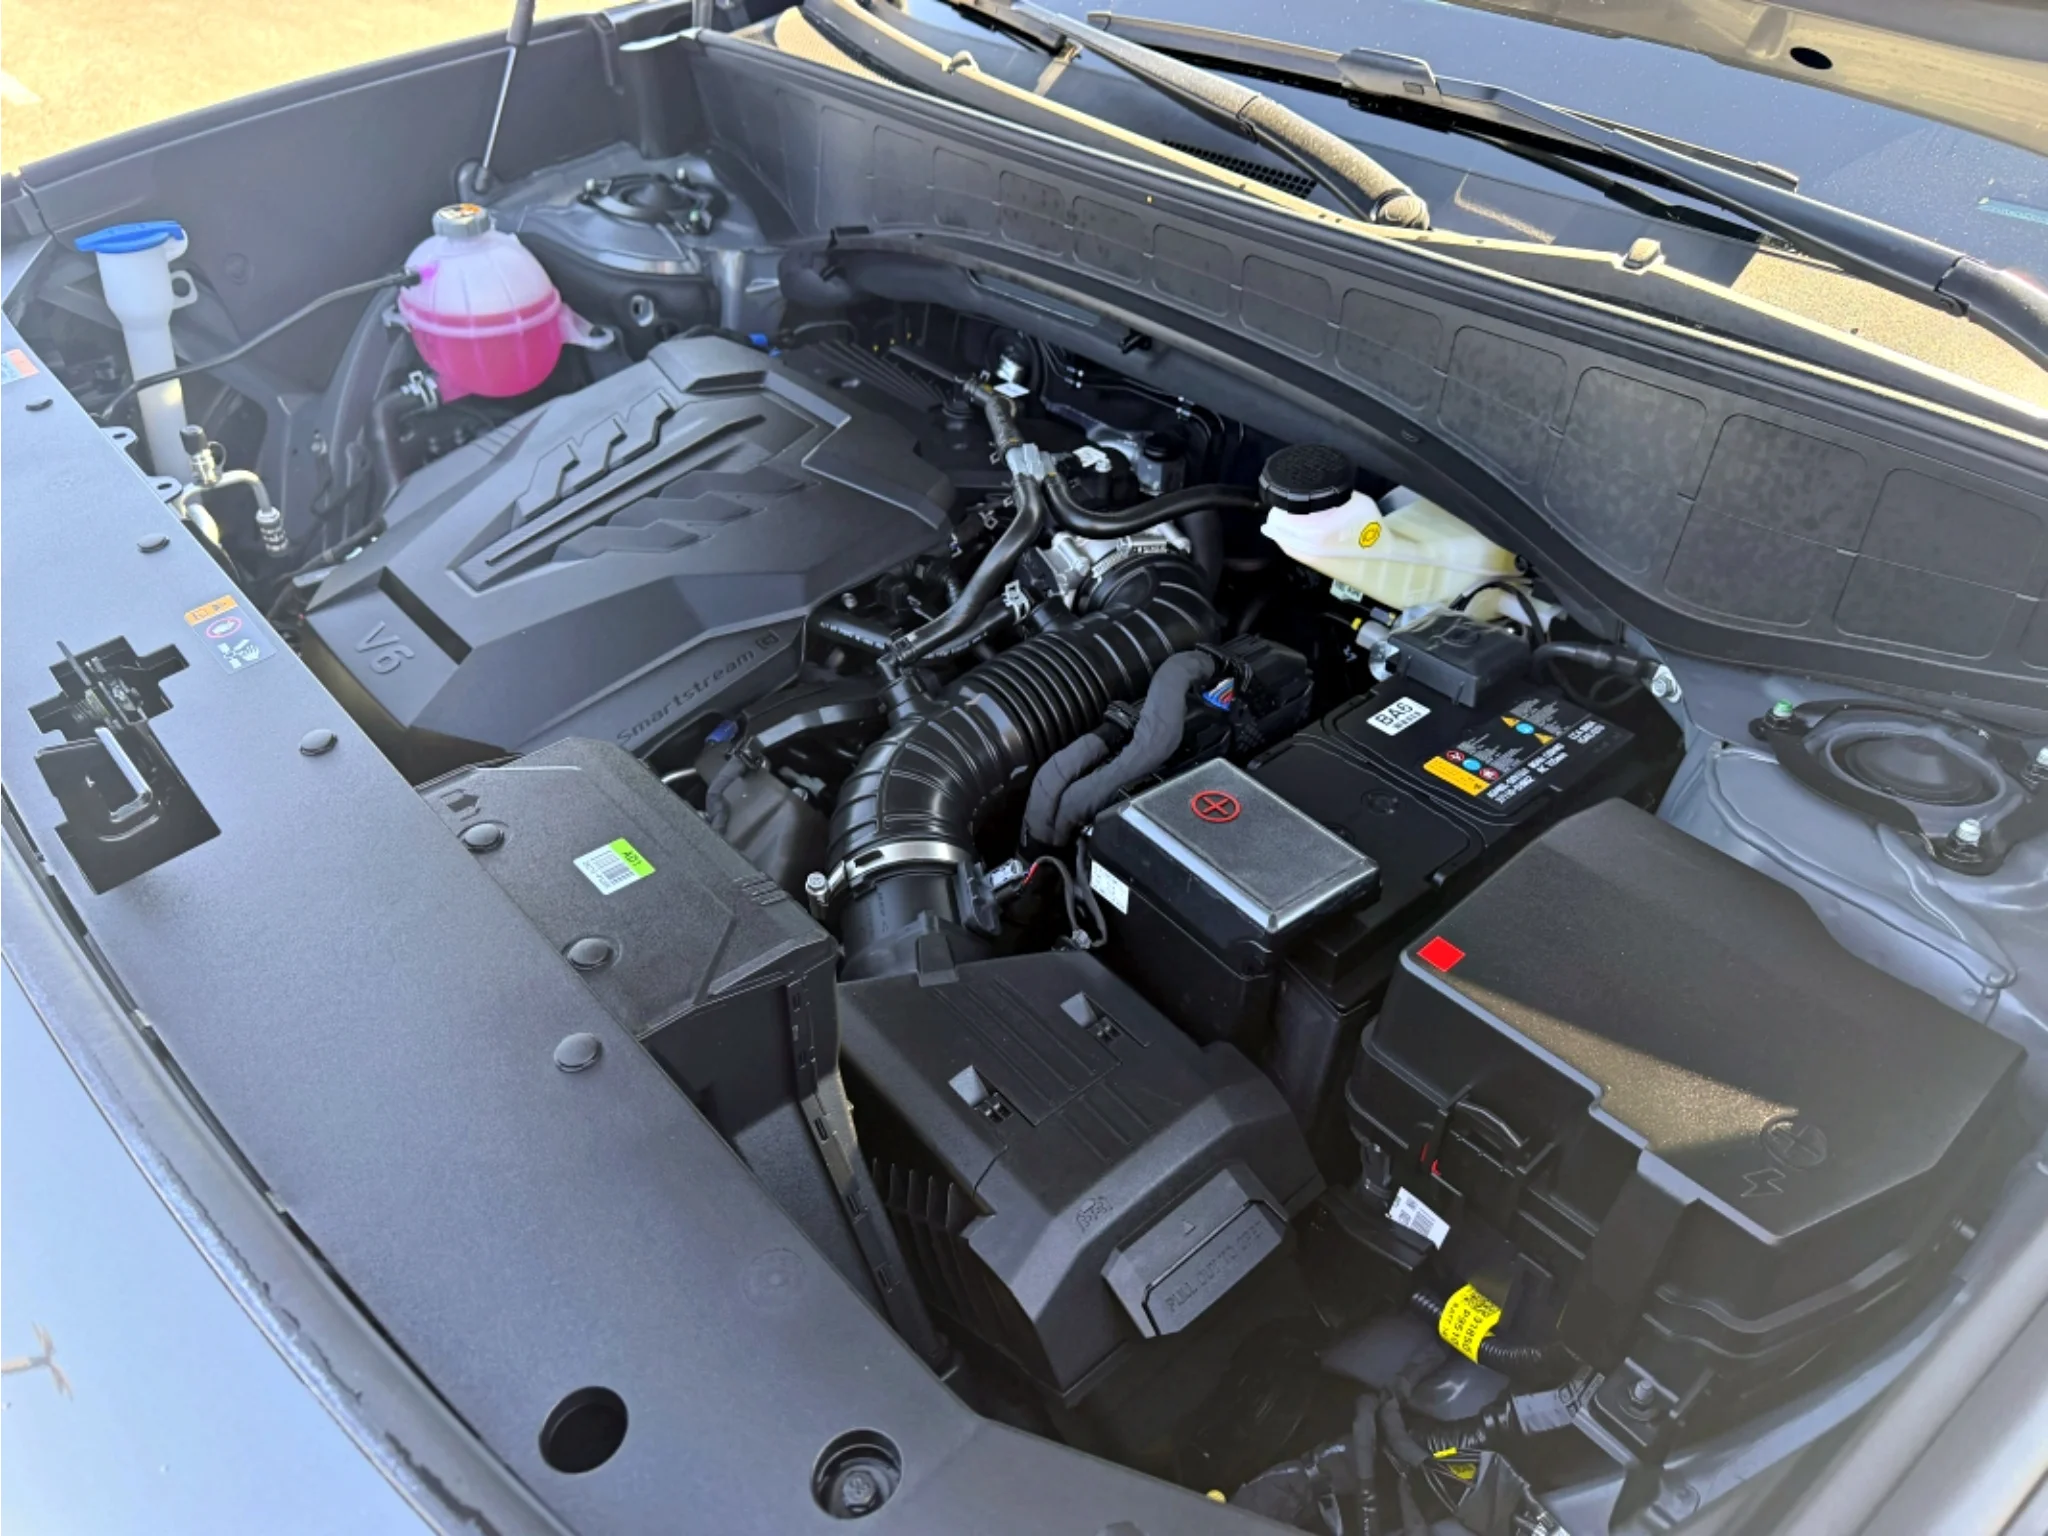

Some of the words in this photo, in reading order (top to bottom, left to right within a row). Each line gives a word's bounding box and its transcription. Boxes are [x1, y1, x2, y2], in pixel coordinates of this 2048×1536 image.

[355, 620, 415, 676] V6
[616, 650, 756, 745] Smartstream
[1164, 1281, 1199, 1312] PULL
